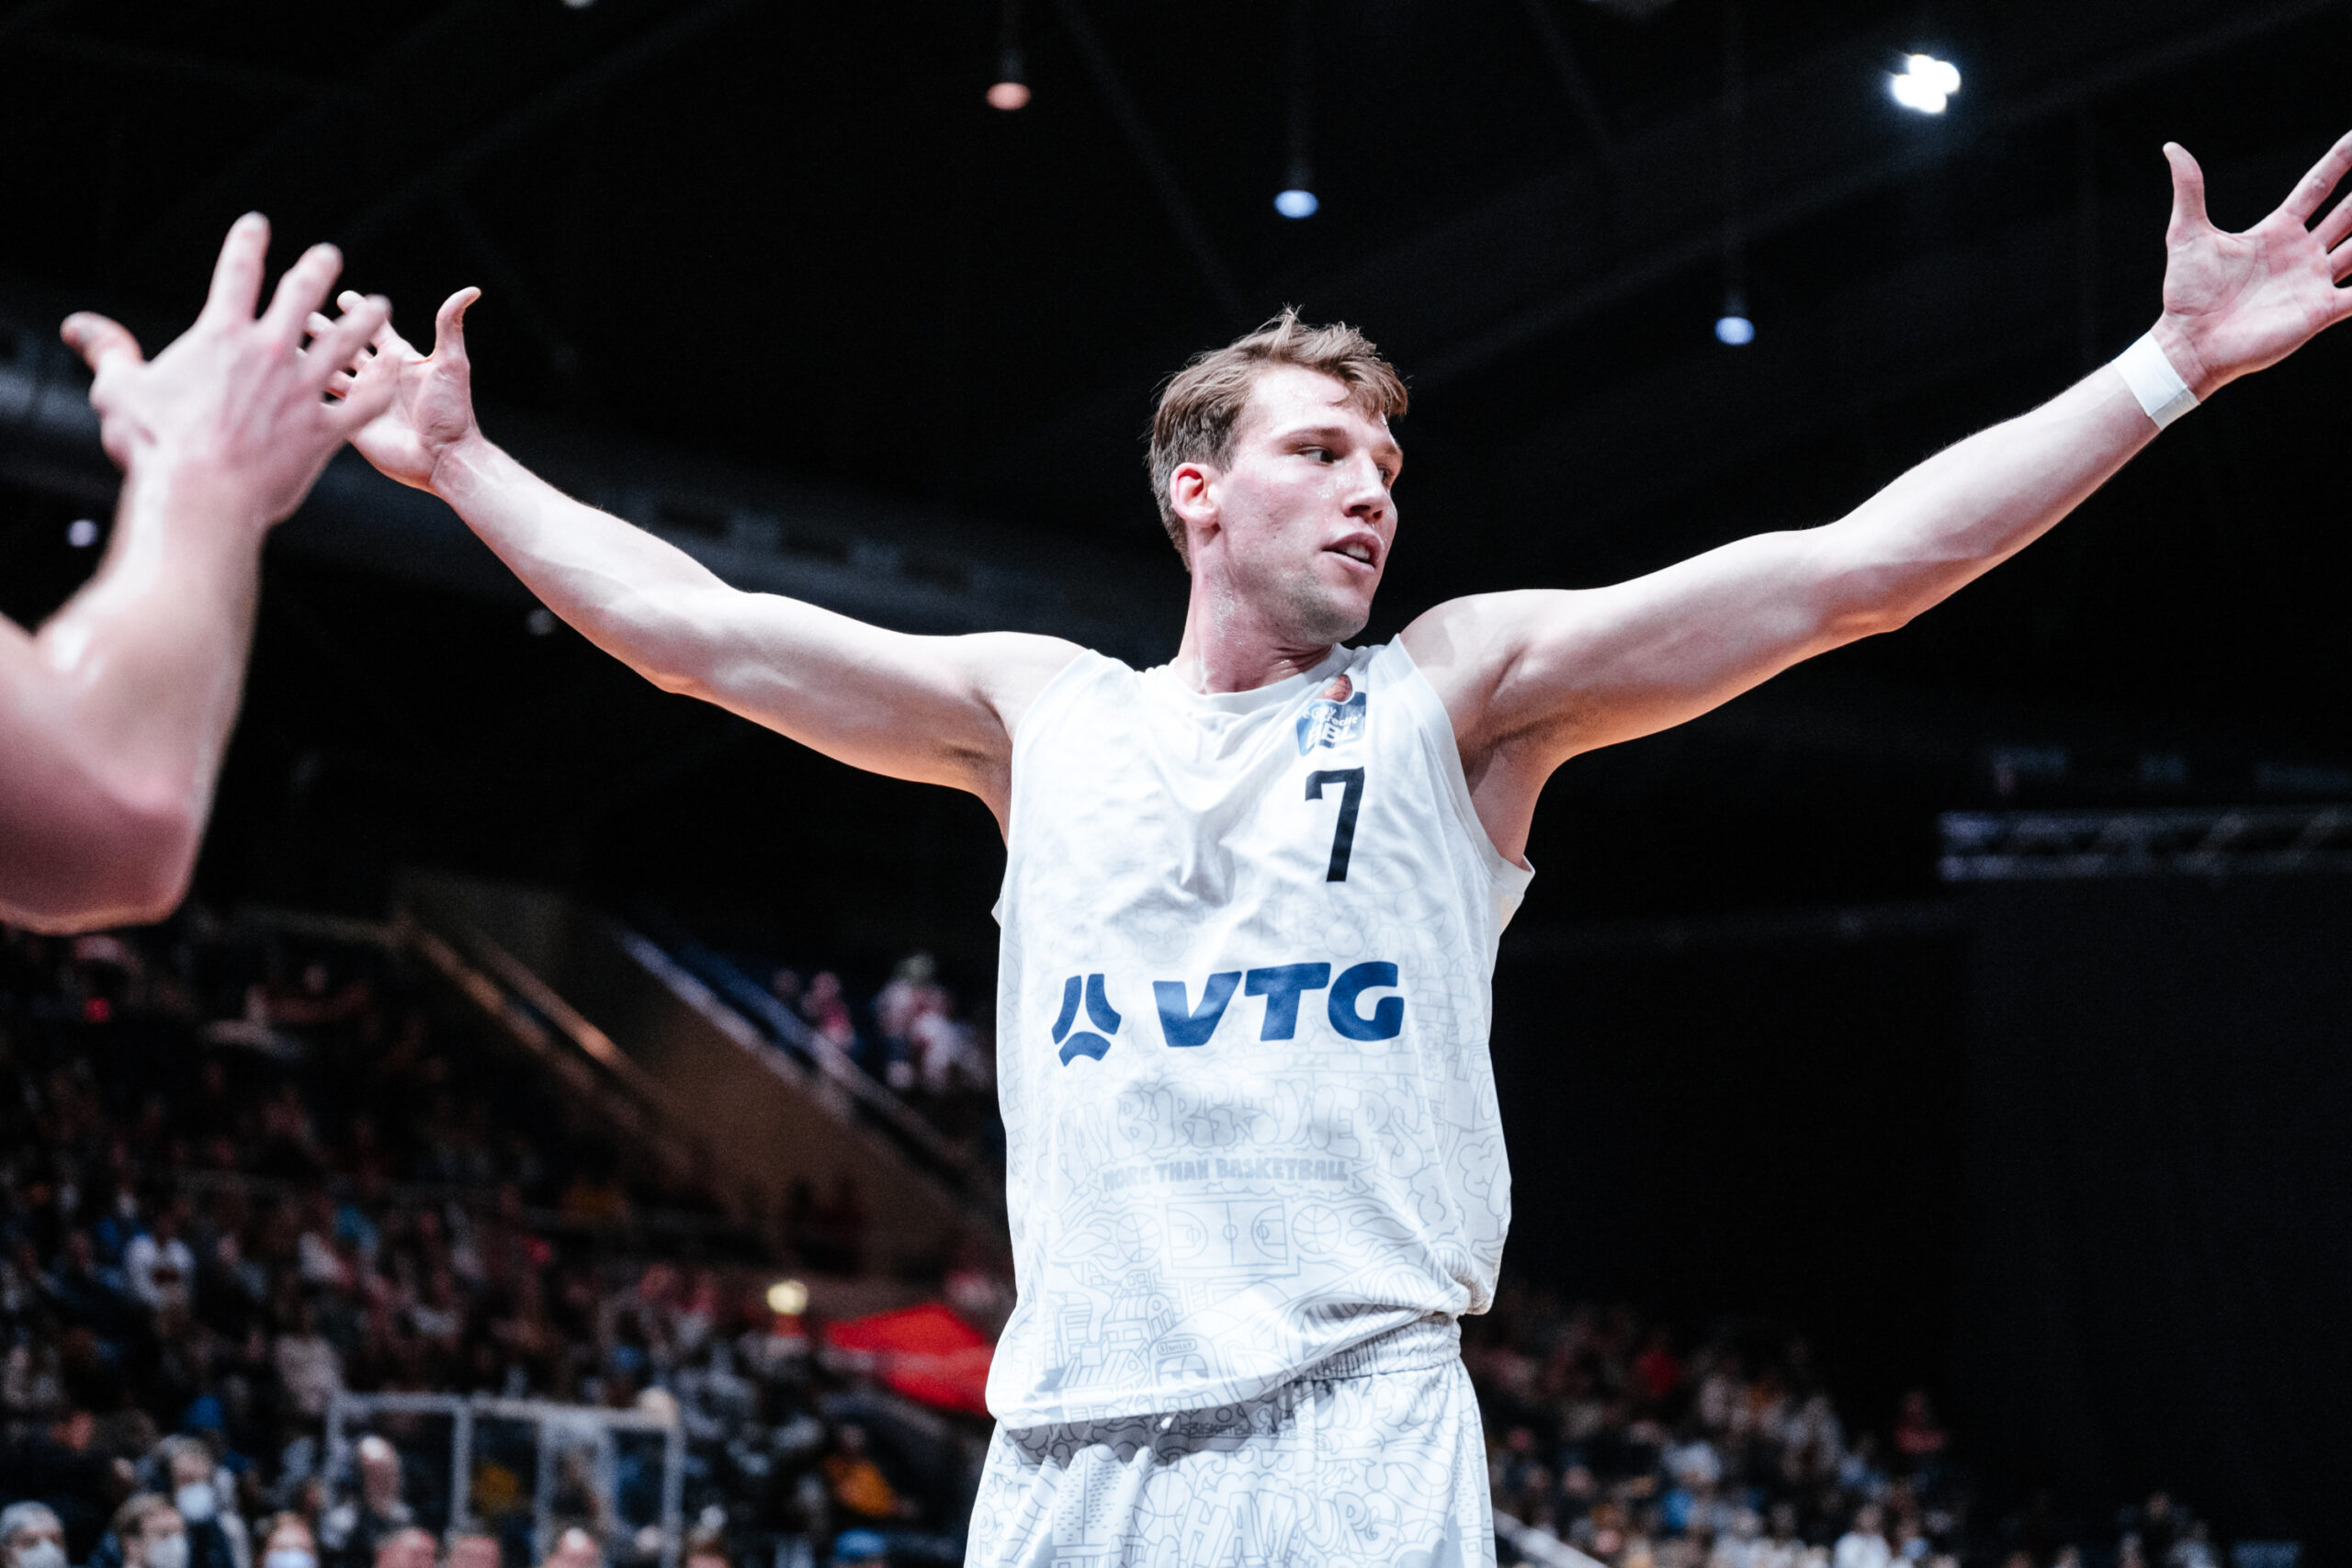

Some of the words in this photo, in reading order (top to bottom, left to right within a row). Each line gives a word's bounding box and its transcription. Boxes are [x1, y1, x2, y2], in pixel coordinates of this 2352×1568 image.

[1305, 766, 1365, 883] 7
[1152, 961, 1405, 1048] VTG
[1102, 1167, 1152, 1193] MORE
[1158, 1160, 1210, 1182] THAN
[1216, 1157, 1349, 1182] BASKETBALL
